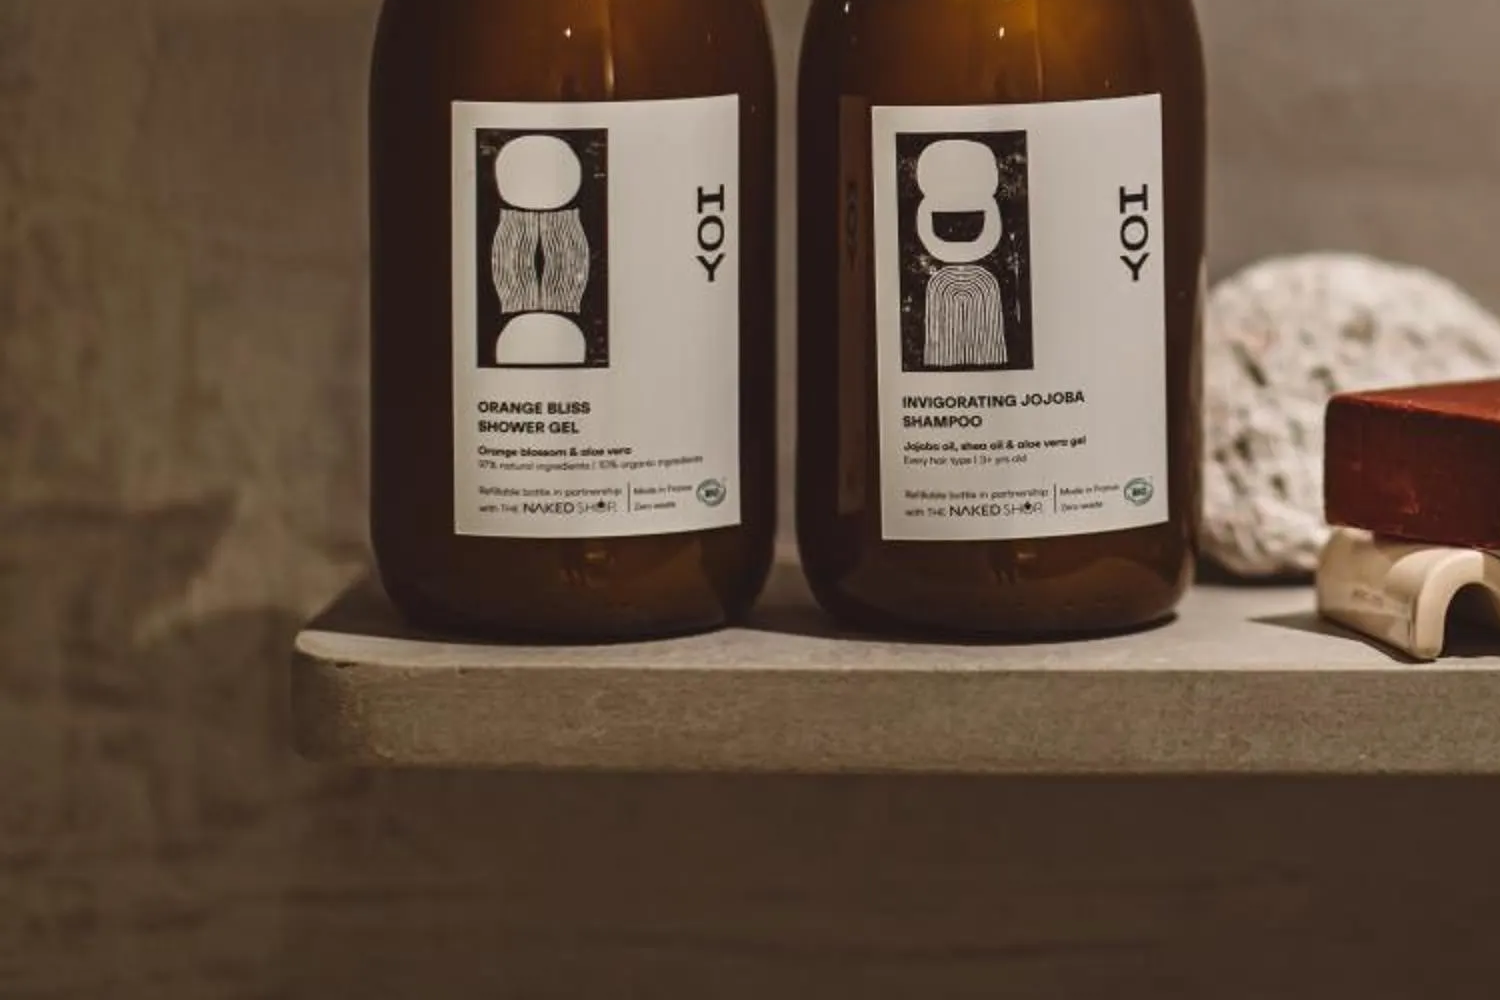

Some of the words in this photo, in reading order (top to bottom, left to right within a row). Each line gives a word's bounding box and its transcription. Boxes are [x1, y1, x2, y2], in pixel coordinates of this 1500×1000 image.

[696, 184, 725, 282] HOY
[1120, 184, 1149, 281] HOY
[902, 394, 1017, 409] INVIGORATING
[1021, 390, 1085, 407] JOJOBA
[477, 401, 542, 415] ORANGE
[548, 401, 591, 415] BLISS
[478, 421, 544, 434] SHOWER
[549, 421, 580, 434] GEL
[903, 415, 983, 428] SHAMPOO
[903, 441, 939, 452] Jojoba
[941, 440, 959, 452] oil,
[961, 440, 987, 450] shea
[990, 440, 1004, 450] oil
[1006, 439, 1014, 449] &
[1017, 439, 1041, 449] aloe
[1044, 439, 1068, 448] vera
[1071, 435, 1086, 448] gel
[477, 446, 517, 458] Orange
[521, 447, 566, 457] blossom
[570, 448, 578, 457] &
[581, 447, 604, 456] aloe
[607, 447, 632, 456] vera
[500, 460, 533, 470] natural
[536, 461, 590, 472] ingredients
[903, 455, 928, 467] Every
[929, 455, 948, 465] hair
[950, 455, 972, 466] type
[479, 486, 520, 496] Refillable
[523, 487, 551, 497] bottle
[553, 487, 562, 496] in
[564, 487, 622, 498] partnership
[905, 490, 946, 500] Refillable
[949, 490, 977, 500] bottle
[979, 490, 988, 499] in
[991, 488, 1049, 501] partnership
[523, 502, 575, 514] NAKED
[949, 503, 1001, 517] NAKED
